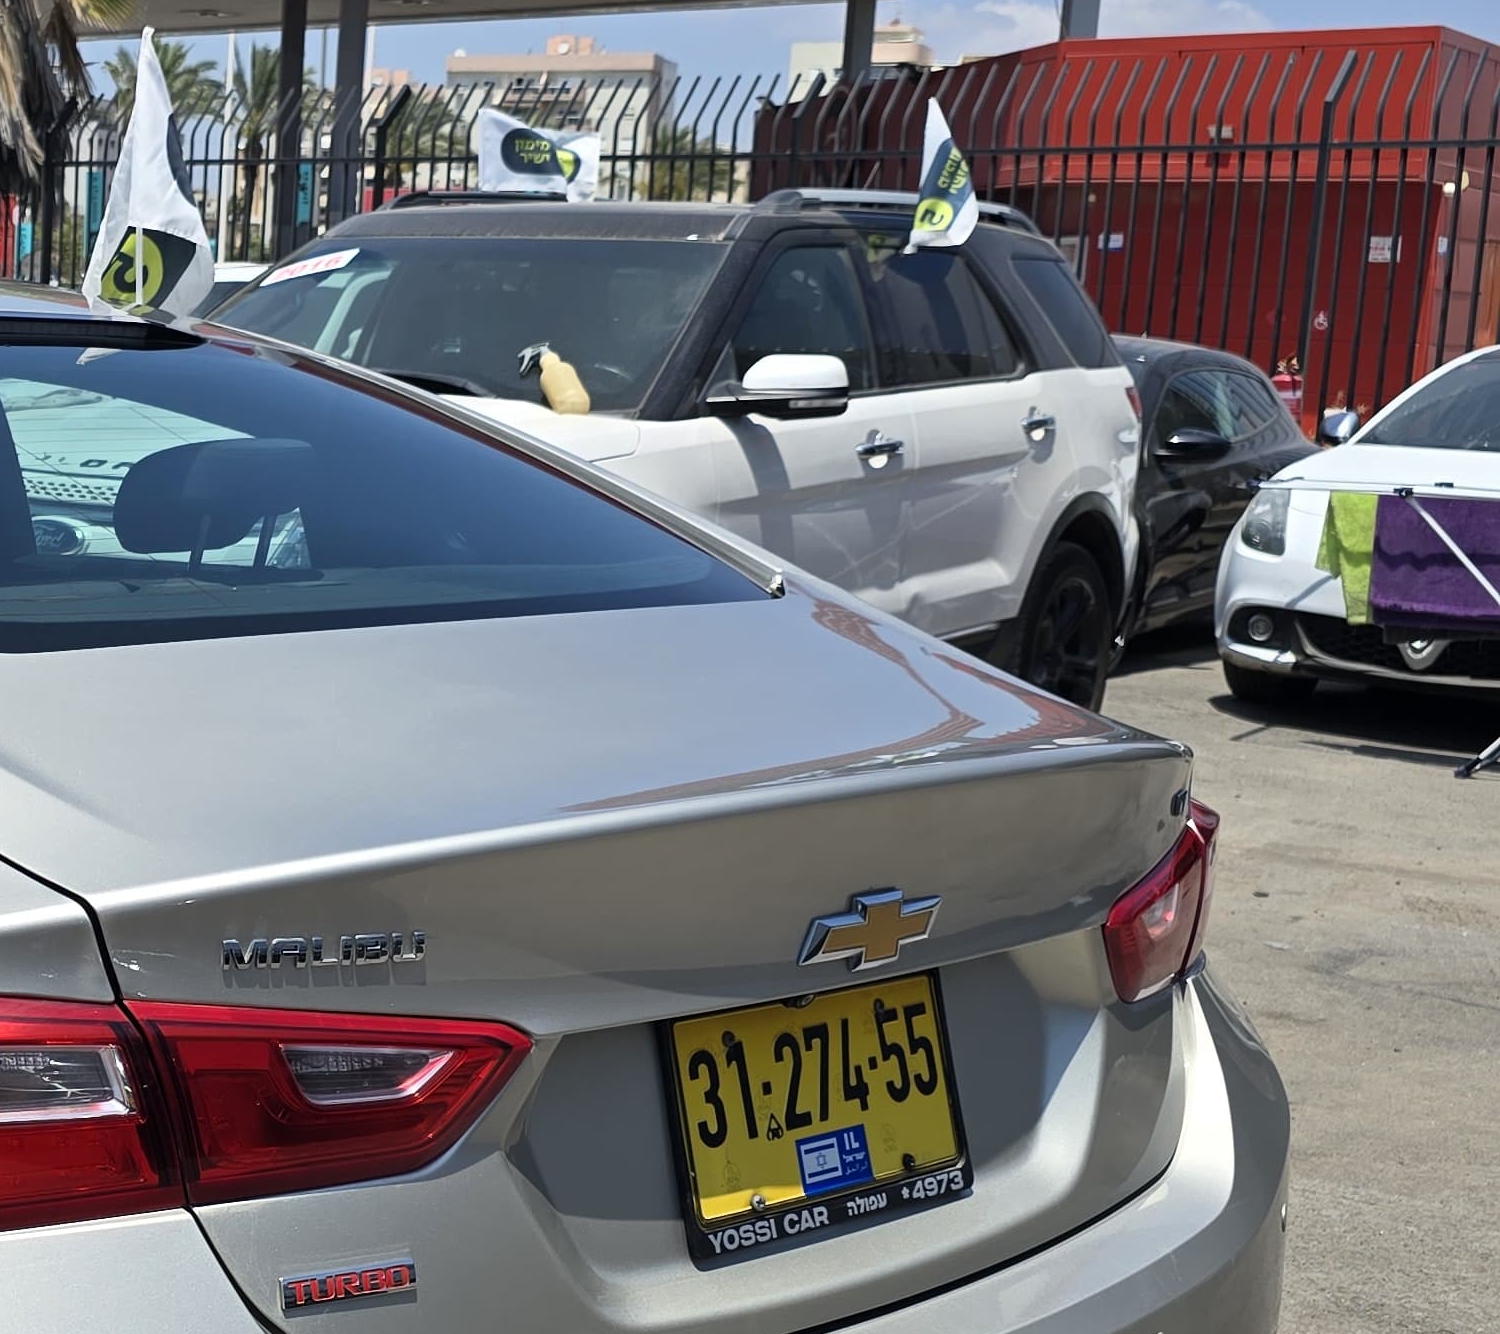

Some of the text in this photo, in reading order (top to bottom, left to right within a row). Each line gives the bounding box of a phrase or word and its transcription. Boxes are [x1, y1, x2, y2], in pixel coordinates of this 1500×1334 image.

[515, 138, 551, 153] מימון
[520, 152, 551, 165] ישיר
[222, 931, 426, 970] MALIBU
[843, 1131, 860, 1150] IL
[708, 1219, 777, 1254] YOSSI
[784, 1206, 830, 1235] CAR
[846, 1192, 888, 1217] עפולה
[288, 1266, 410, 1305] TURBO
